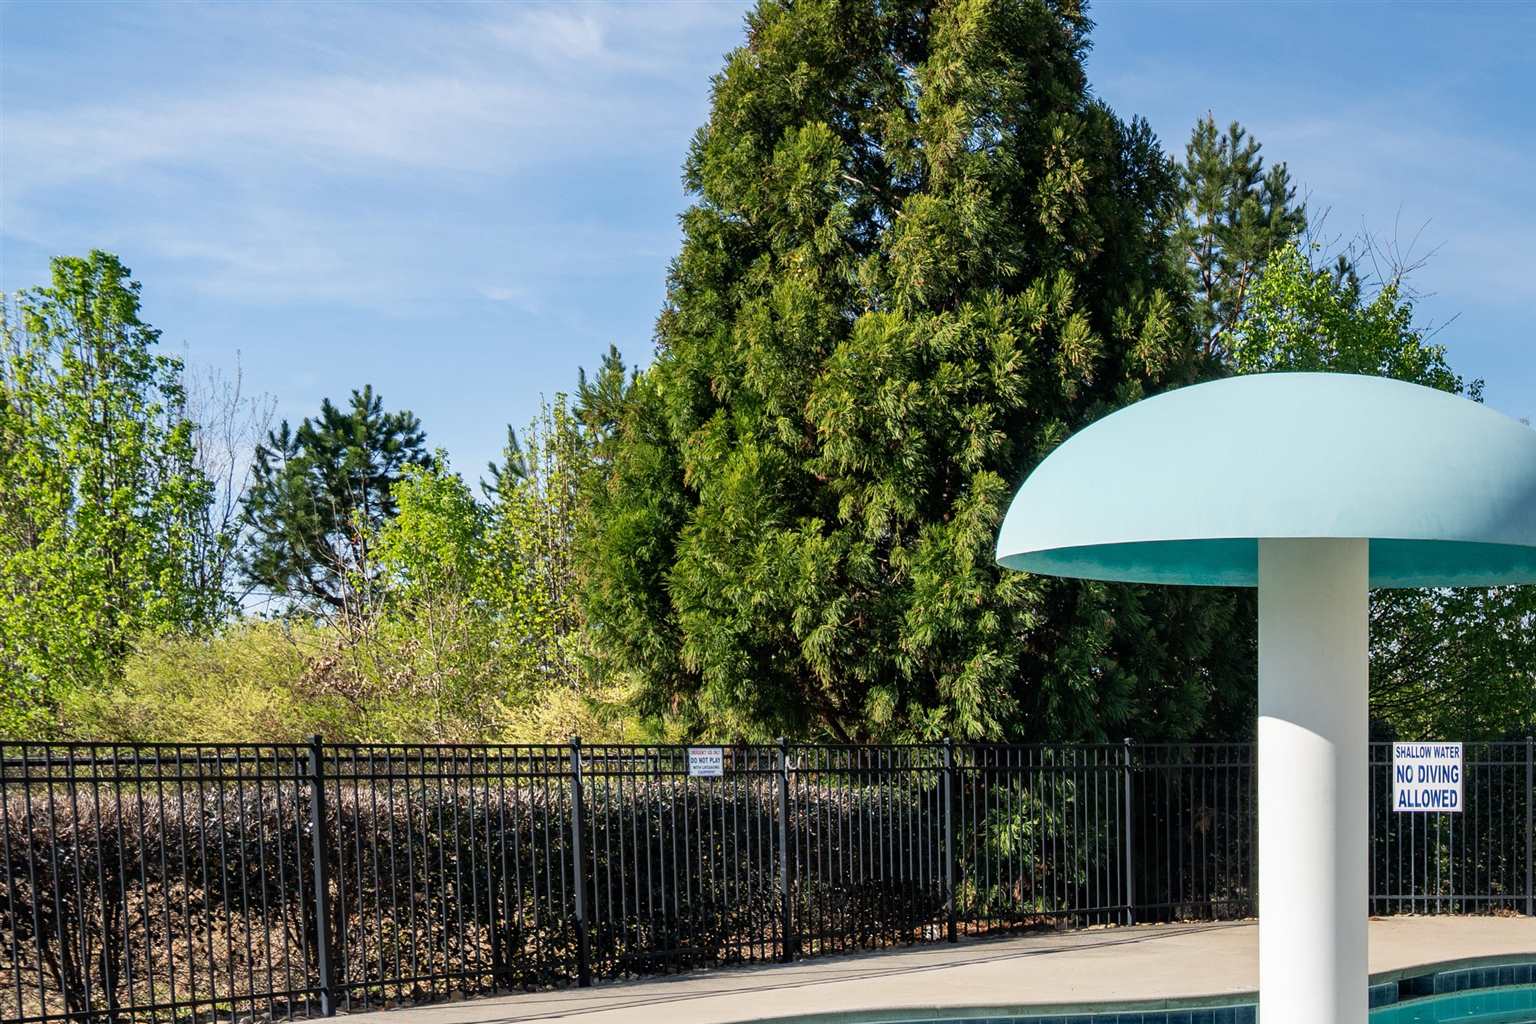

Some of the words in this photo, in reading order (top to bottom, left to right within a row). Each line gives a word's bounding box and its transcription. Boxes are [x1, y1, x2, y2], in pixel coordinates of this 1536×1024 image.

[1396, 746, 1432, 758] SHALLOW
[1434, 746, 1460, 758] WATER
[1397, 765, 1413, 783] NO
[1418, 765, 1459, 783] DIVING
[1399, 789, 1457, 807] ALLOWED
